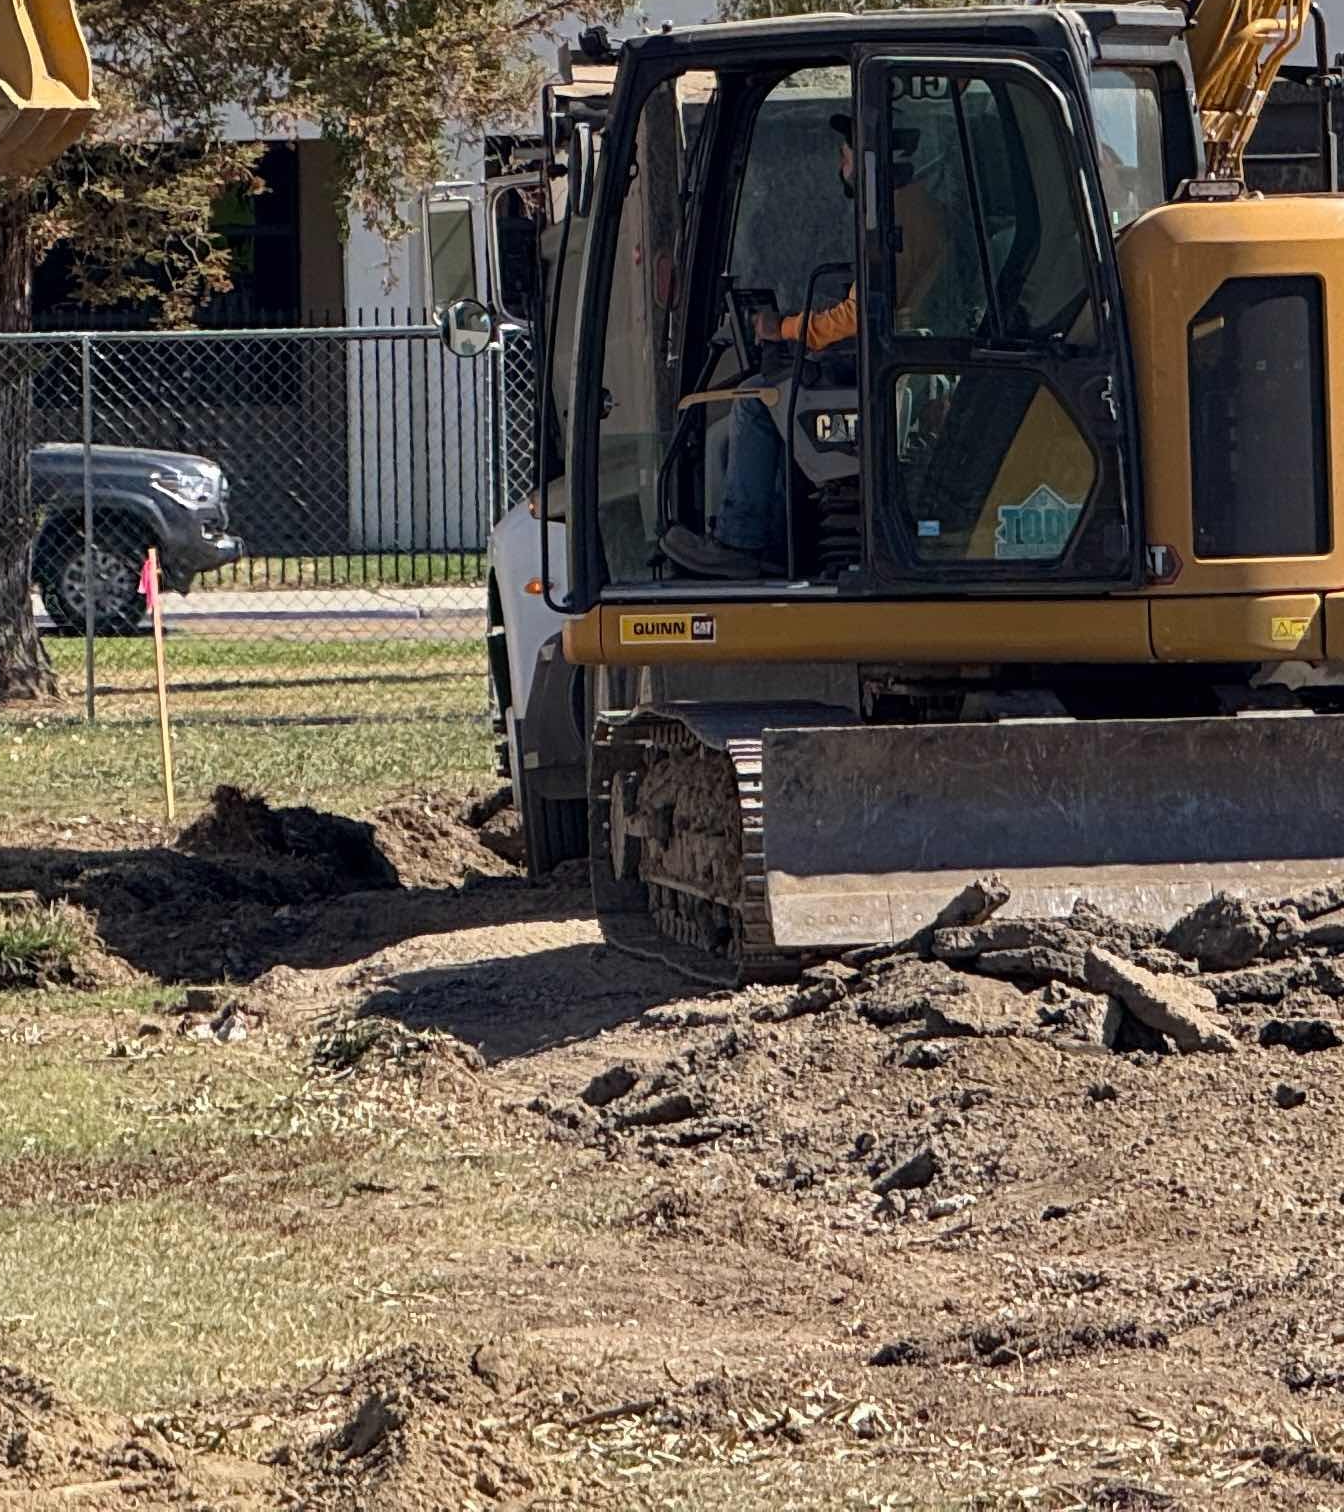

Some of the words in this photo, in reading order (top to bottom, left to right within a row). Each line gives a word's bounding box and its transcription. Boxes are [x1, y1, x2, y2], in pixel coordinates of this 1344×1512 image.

[816, 413, 859, 442] CAT
[633, 621, 686, 636] QUINN
[692, 620, 713, 635] CAT
